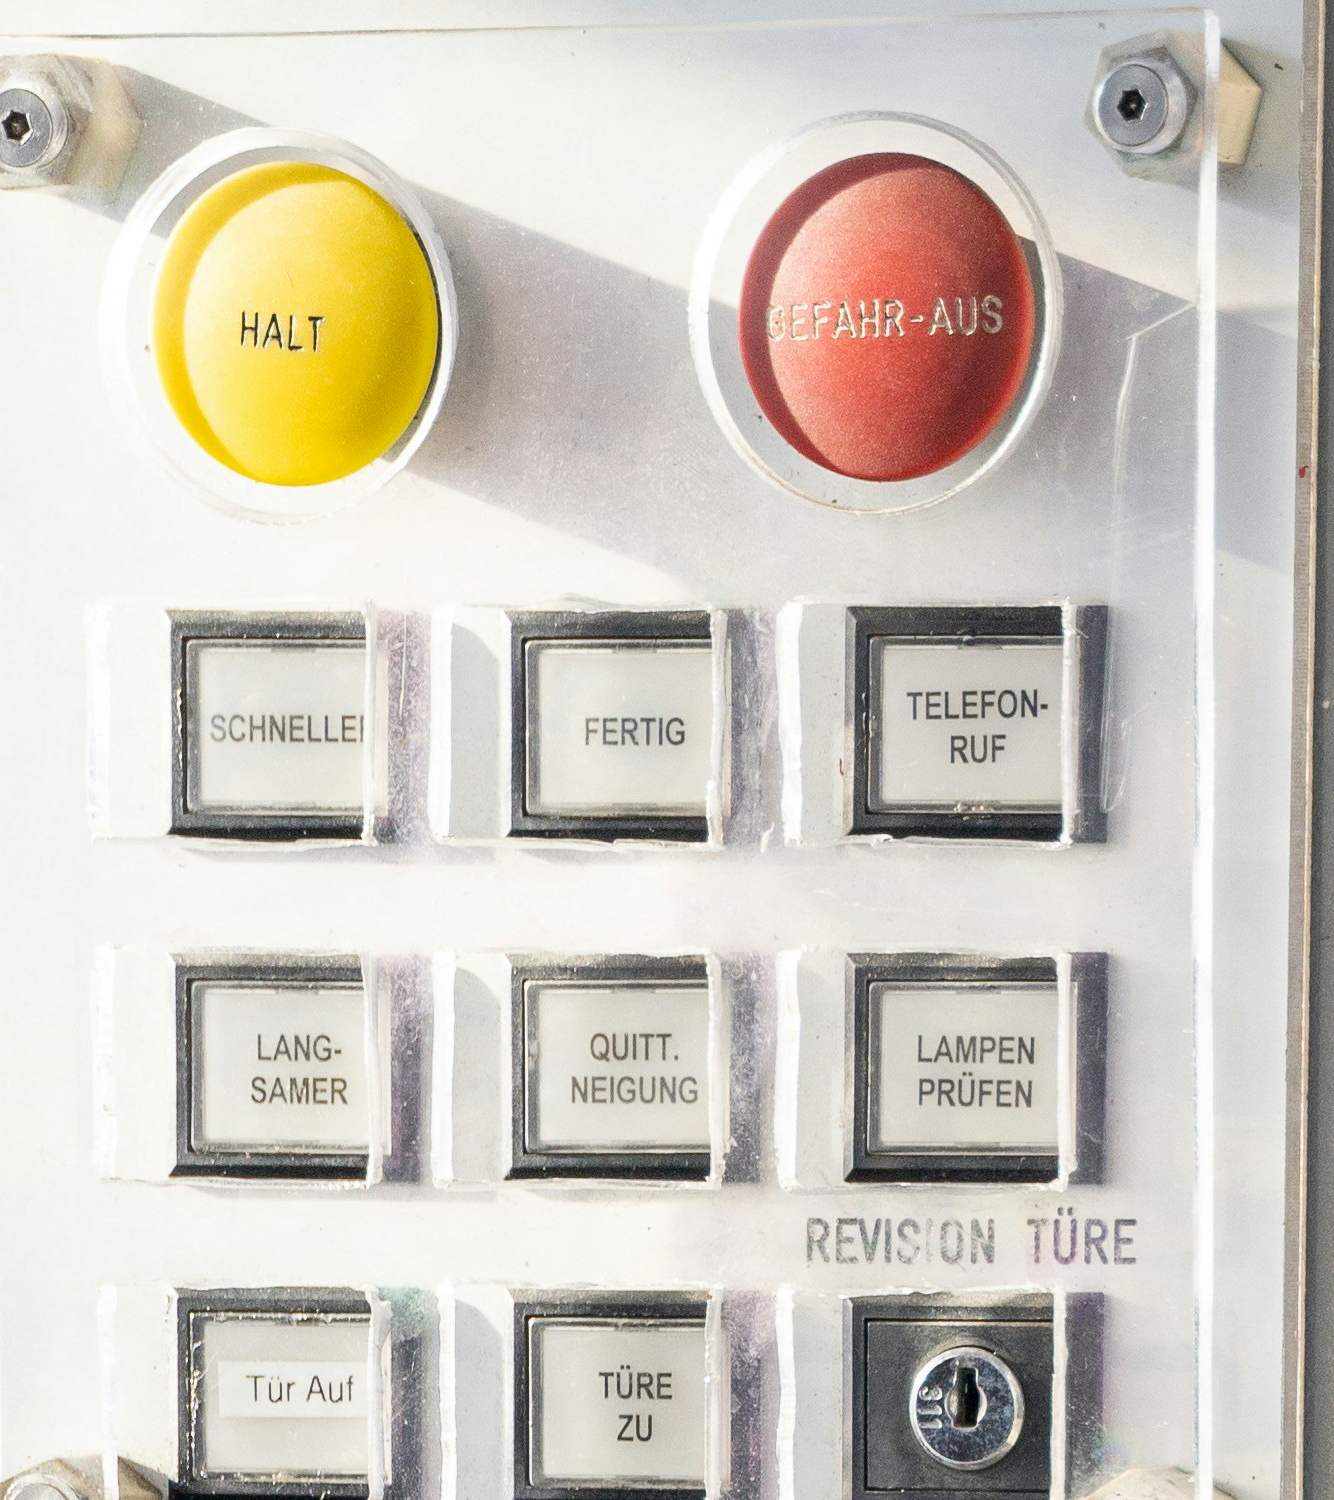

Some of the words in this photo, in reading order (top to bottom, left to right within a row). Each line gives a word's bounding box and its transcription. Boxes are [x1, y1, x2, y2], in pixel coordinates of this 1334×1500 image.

[239, 310, 325, 354] HALT
[767, 295, 1004, 341] GEFAHR-AUS
[905, 688, 1050, 721] TELEFON-
[584, 716, 687, 747] FERTIG
[949, 733, 1008, 765] RUF
[256, 1033, 343, 1063] LANG-
[589, 1032, 680, 1064] QUITT.
[916, 1033, 1036, 1066] LAMPEN
[250, 1075, 349, 1106] SAMER
[570, 1074, 699, 1105] NEIGUNG
[917, 1073, 1034, 1109] PRÜFEN
[805, 1215, 997, 1268] REVISION
[1027, 1210, 1139, 1266] TÜRE
[244, 1373, 298, 1405] Tür
[305, 1374, 354, 1404] Auf
[597, 1364, 674, 1401] TÜRE
[616, 1413, 654, 1443] ZU
